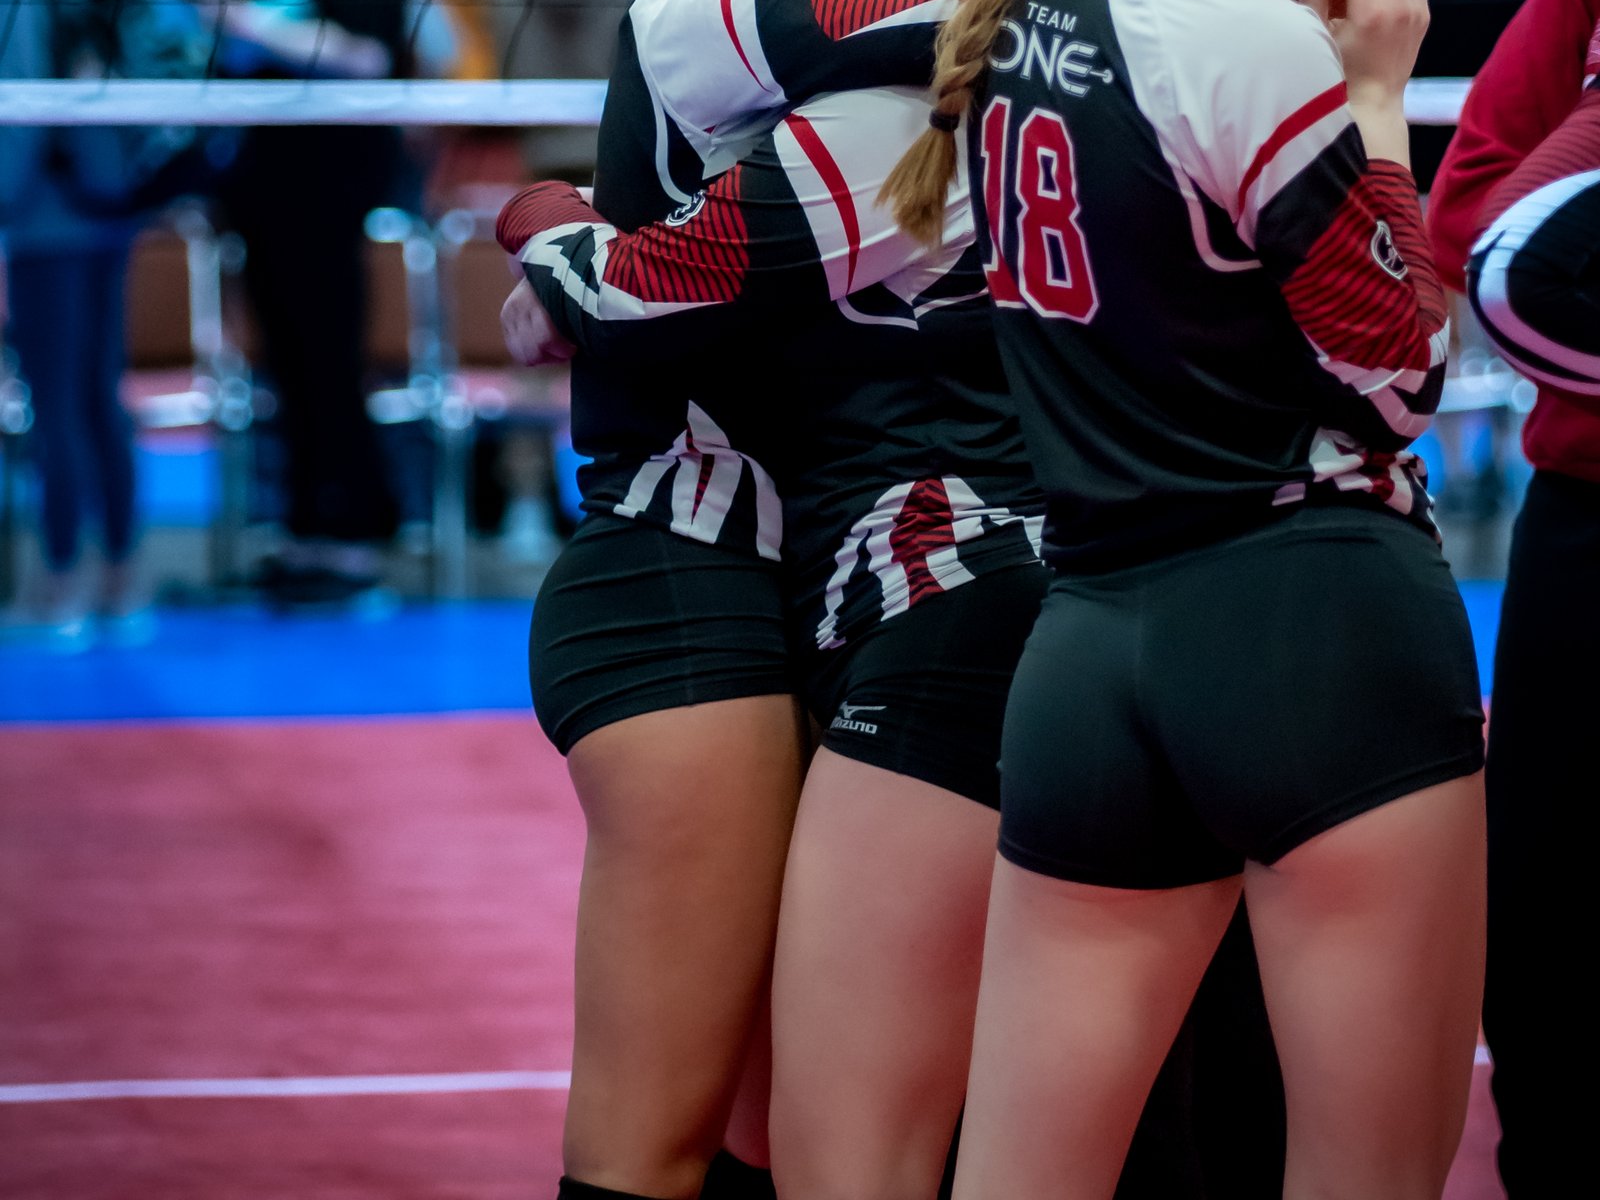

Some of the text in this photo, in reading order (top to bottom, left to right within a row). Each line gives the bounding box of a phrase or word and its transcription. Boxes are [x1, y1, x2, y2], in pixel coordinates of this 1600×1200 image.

[987, 17, 1099, 98] ONE
[1027, 1, 1078, 33] TEAM
[980, 95, 1099, 325] 18
